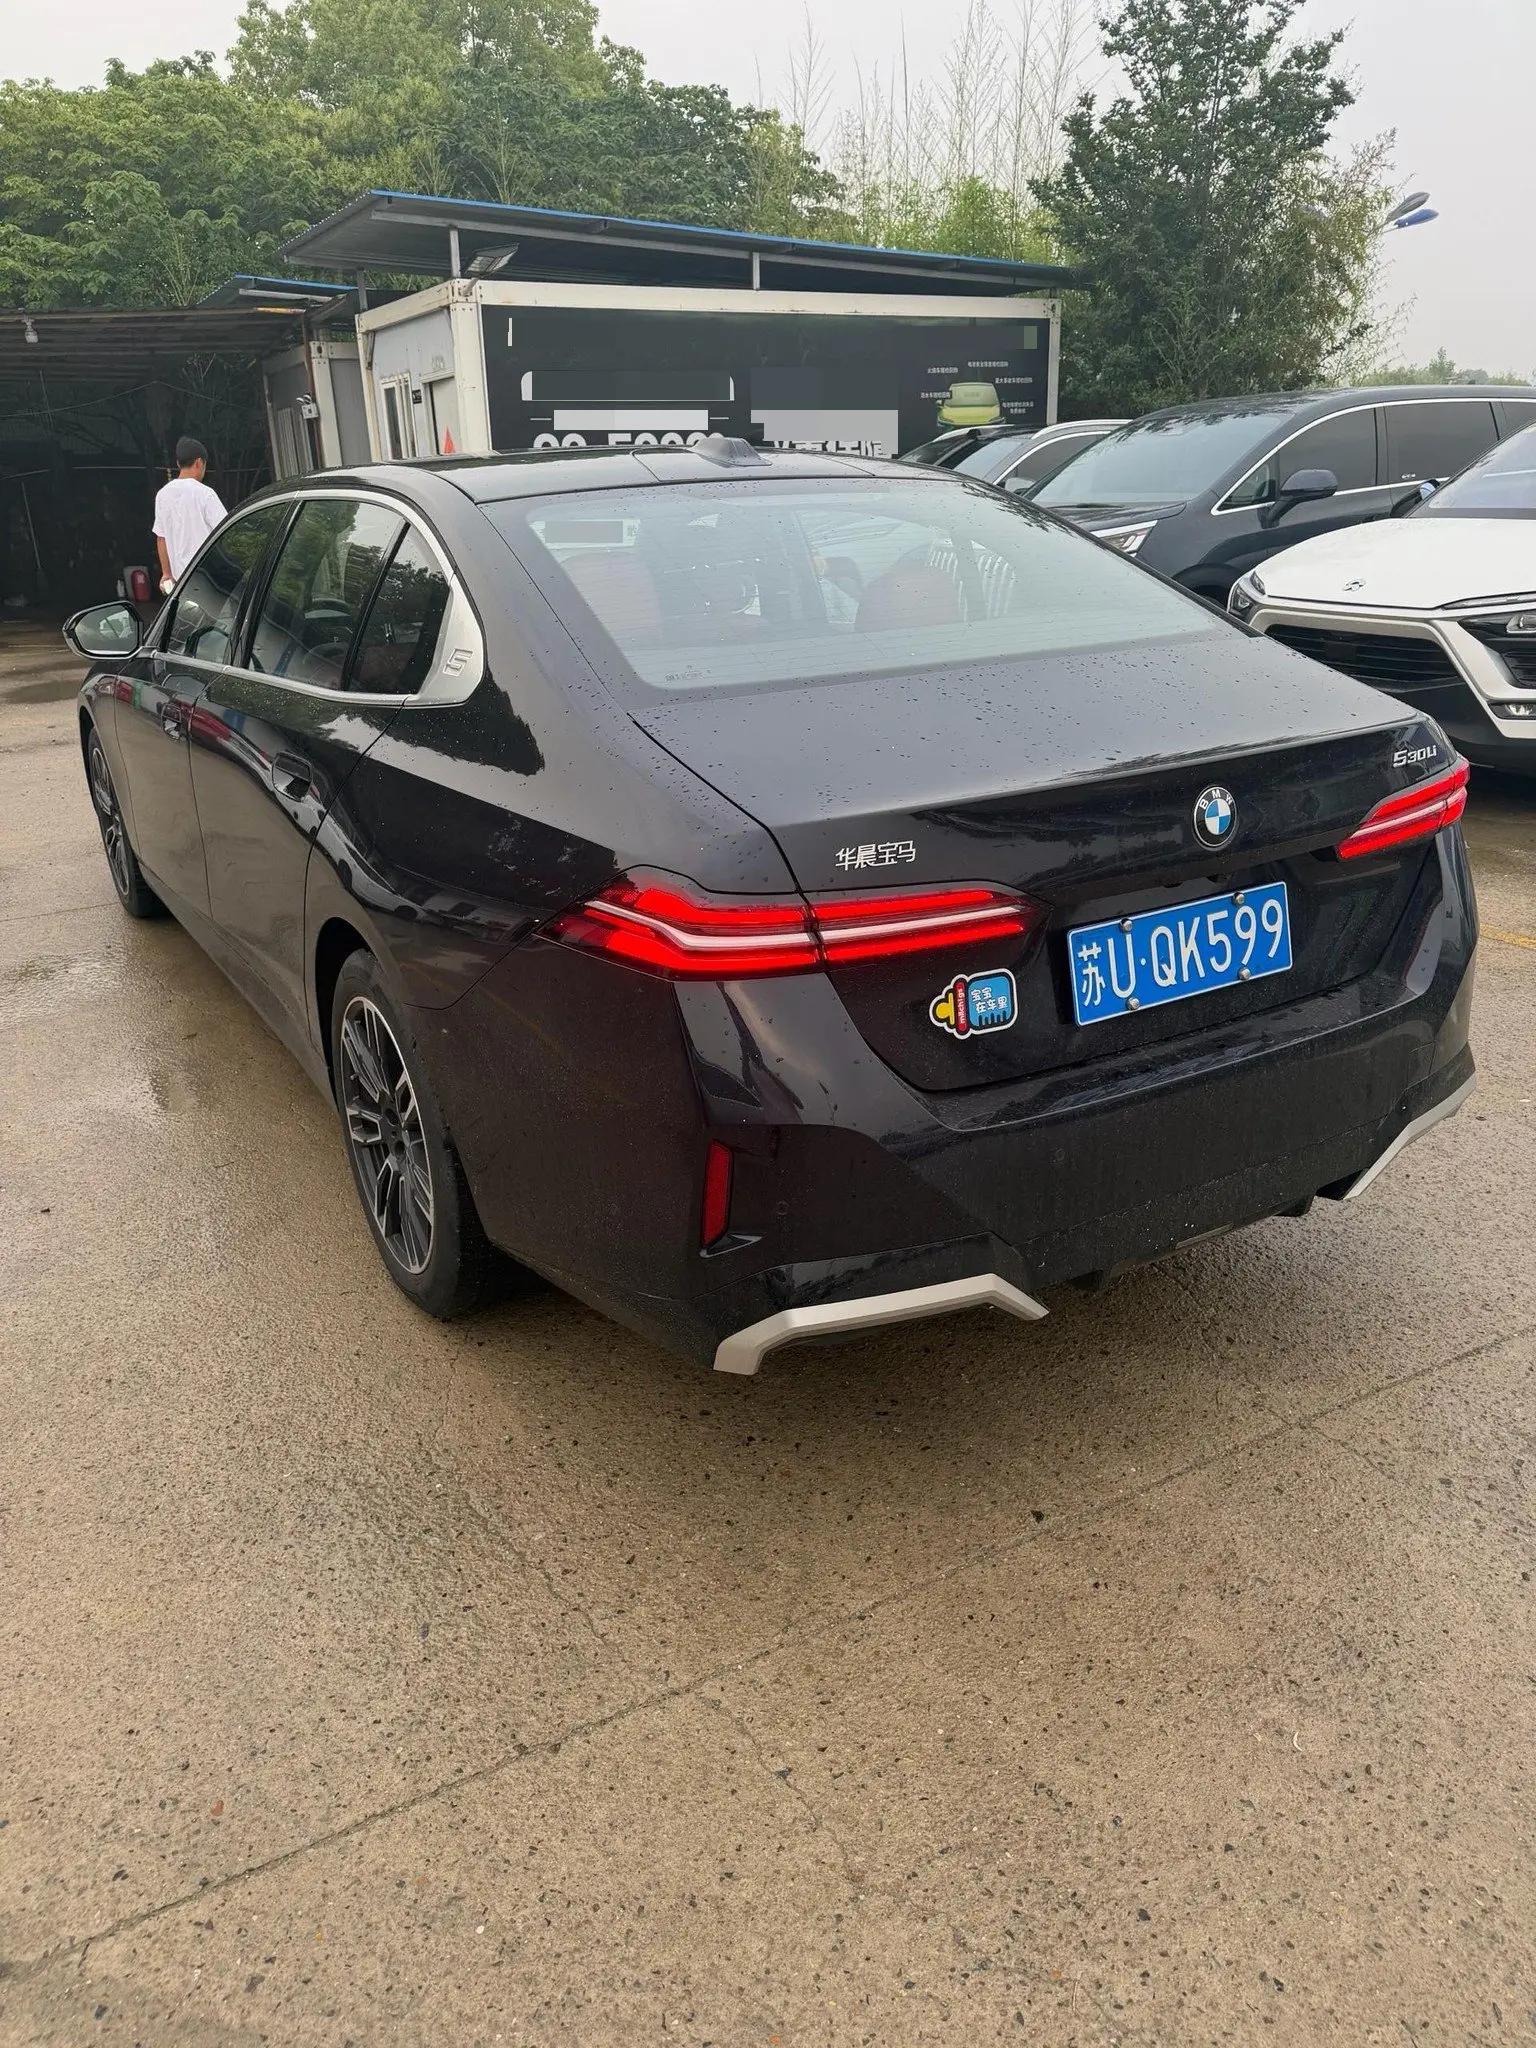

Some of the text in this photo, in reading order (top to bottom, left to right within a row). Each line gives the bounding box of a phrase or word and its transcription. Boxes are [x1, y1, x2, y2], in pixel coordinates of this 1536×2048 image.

[1199, 788, 1233, 811] BMW
[835, 840, 916, 871] 华晨宝马
[957, 988, 966, 1024] milchigs
[971, 987, 992, 1002] 宝宝
[976, 996, 1008, 1013] 在车里
